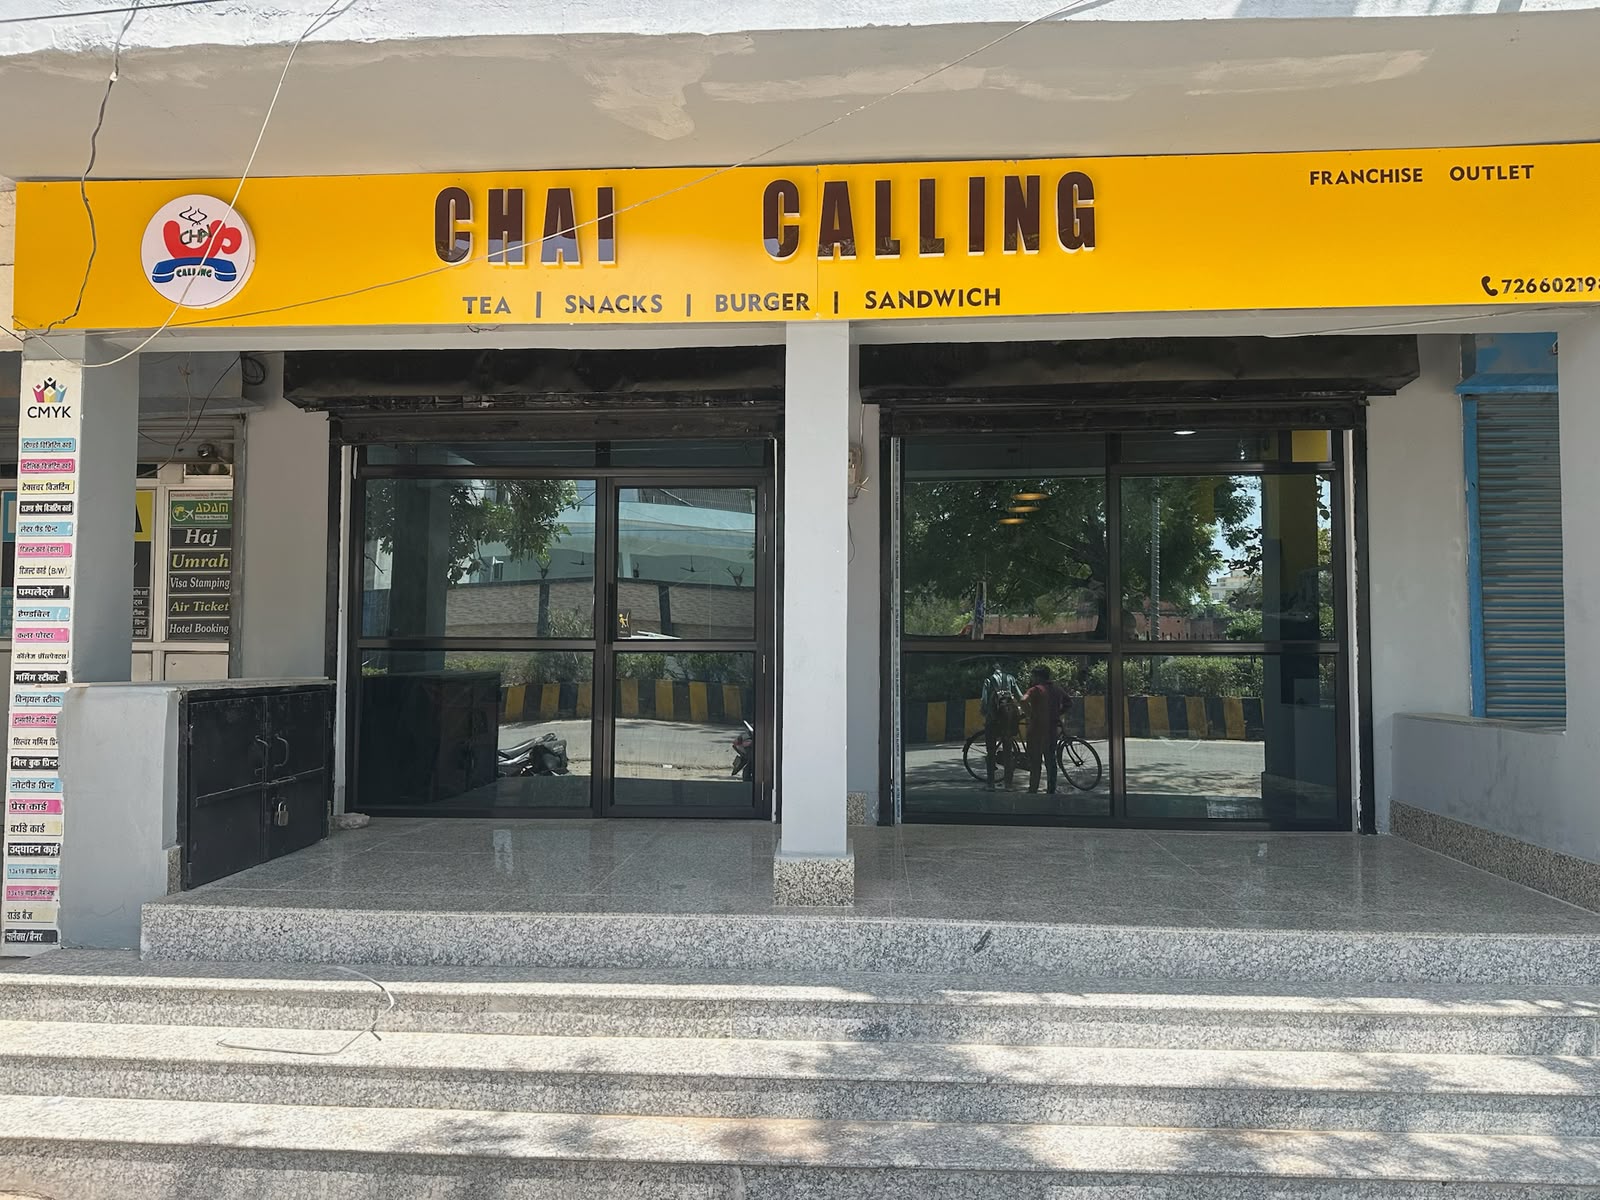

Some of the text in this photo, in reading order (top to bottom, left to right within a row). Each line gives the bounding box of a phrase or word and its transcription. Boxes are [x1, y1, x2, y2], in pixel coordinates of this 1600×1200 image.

[1309, 164, 1535, 186] FRANCHISE OUTLET
[434, 171, 1095, 265] CHAI CALLING
[1502, 276, 1600, 294] 72660219
[462, 296, 511, 315] TEA
[565, 294, 663, 314] SNACKS
[715, 292, 810, 313] BURGER
[864, 287, 1001, 310] SANDWICH
[27, 405, 72, 419] CMYK
[195, 502, 229, 513] ADAM
[184, 528, 218, 547] Haj
[172, 553, 229, 568] Umrah
[170, 576, 231, 590] Visa Stamping
[170, 601, 229, 612] Air Ticket
[169, 623, 229, 635] Hotel Booking
[12, 757, 27, 767] बिल
[28, 758, 41, 768] बुक
[11, 801, 47, 811] प्रेस कार्ड
[29, 822, 46, 833] कार्ड
[43, 843, 60, 854] कार्ड
[7, 909, 21, 919] राउंड
